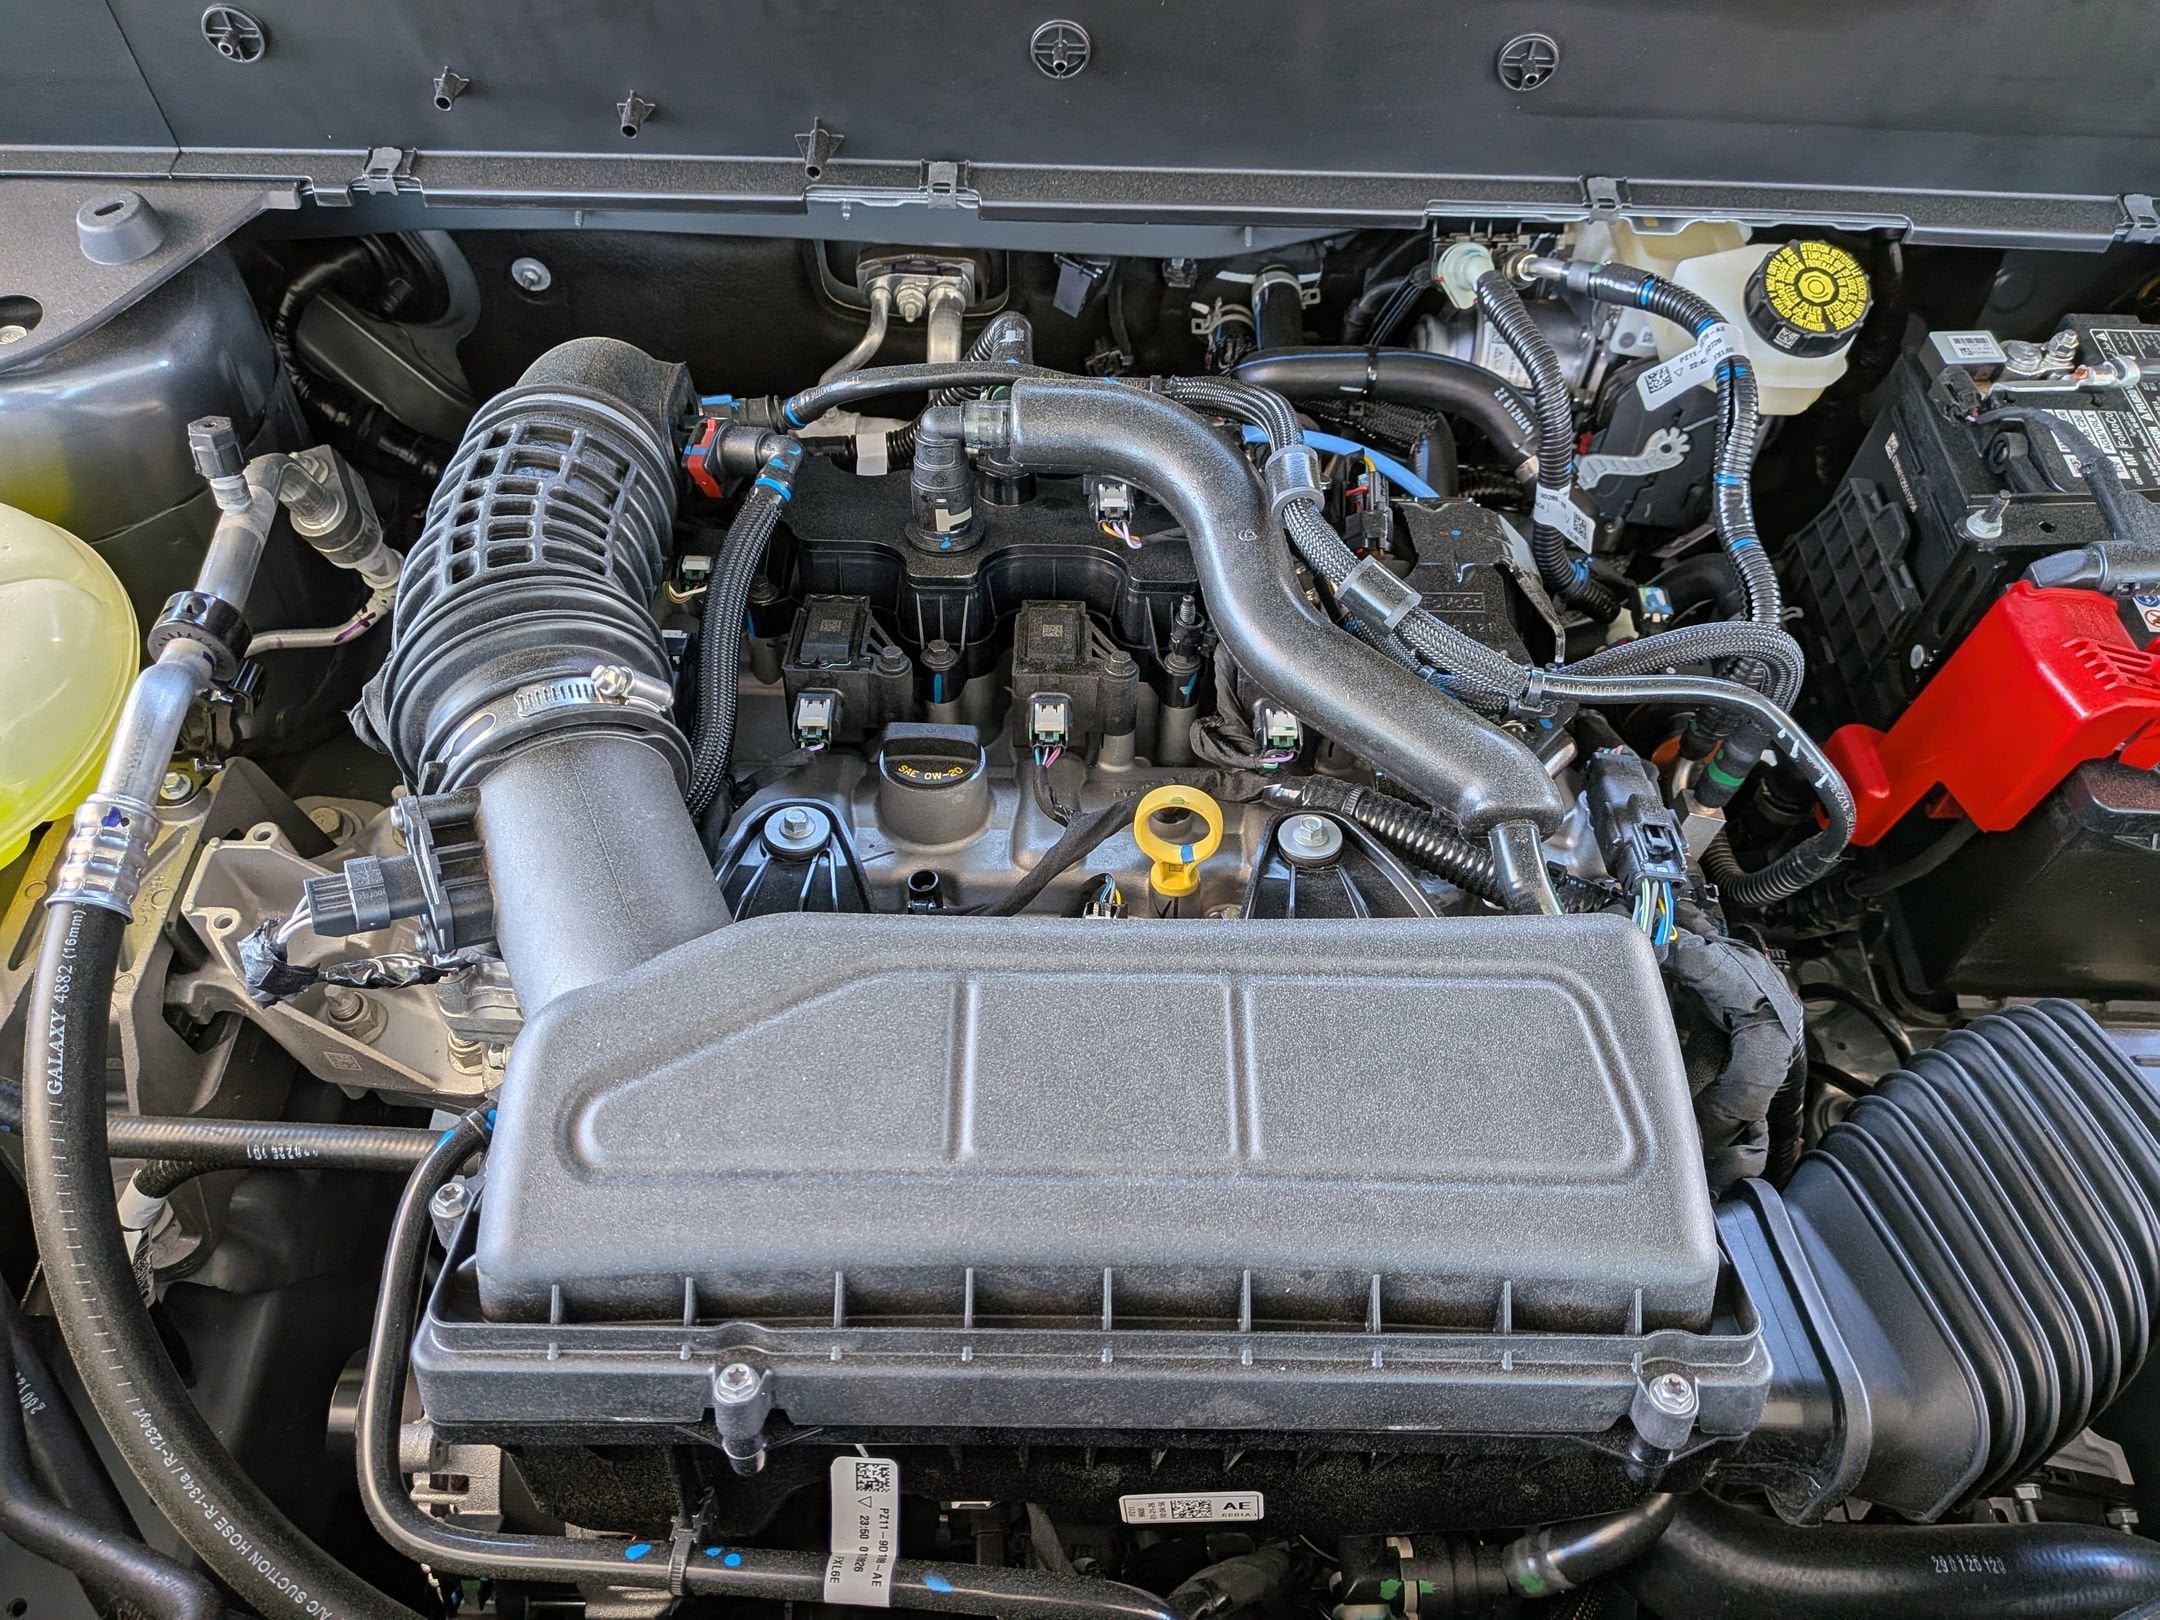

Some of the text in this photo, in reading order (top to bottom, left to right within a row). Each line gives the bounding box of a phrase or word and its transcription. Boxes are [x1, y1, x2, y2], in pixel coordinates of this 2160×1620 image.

[1772, 298, 1791, 317] SEALED
[1785, 285, 1801, 304] CLEAN
[2088, 414, 2111, 449] AGM/VRLA
[2102, 412, 2128, 445] FoMoCo
[898, 765, 919, 778] SAE
[45, 908, 85, 1094] GALAXY 4882 (16mm)
[132, 1409, 176, 1466] R-1234yf
[181, 1473, 218, 1519] R-134a
[1222, 1501, 1251, 1510] AE
[214, 1517, 251, 1554] HOSE
[859, 1515, 869, 1539] 23:50
[249, 1552, 306, 1603] SUCTION
[306, 1600, 334, 1620] A/C
